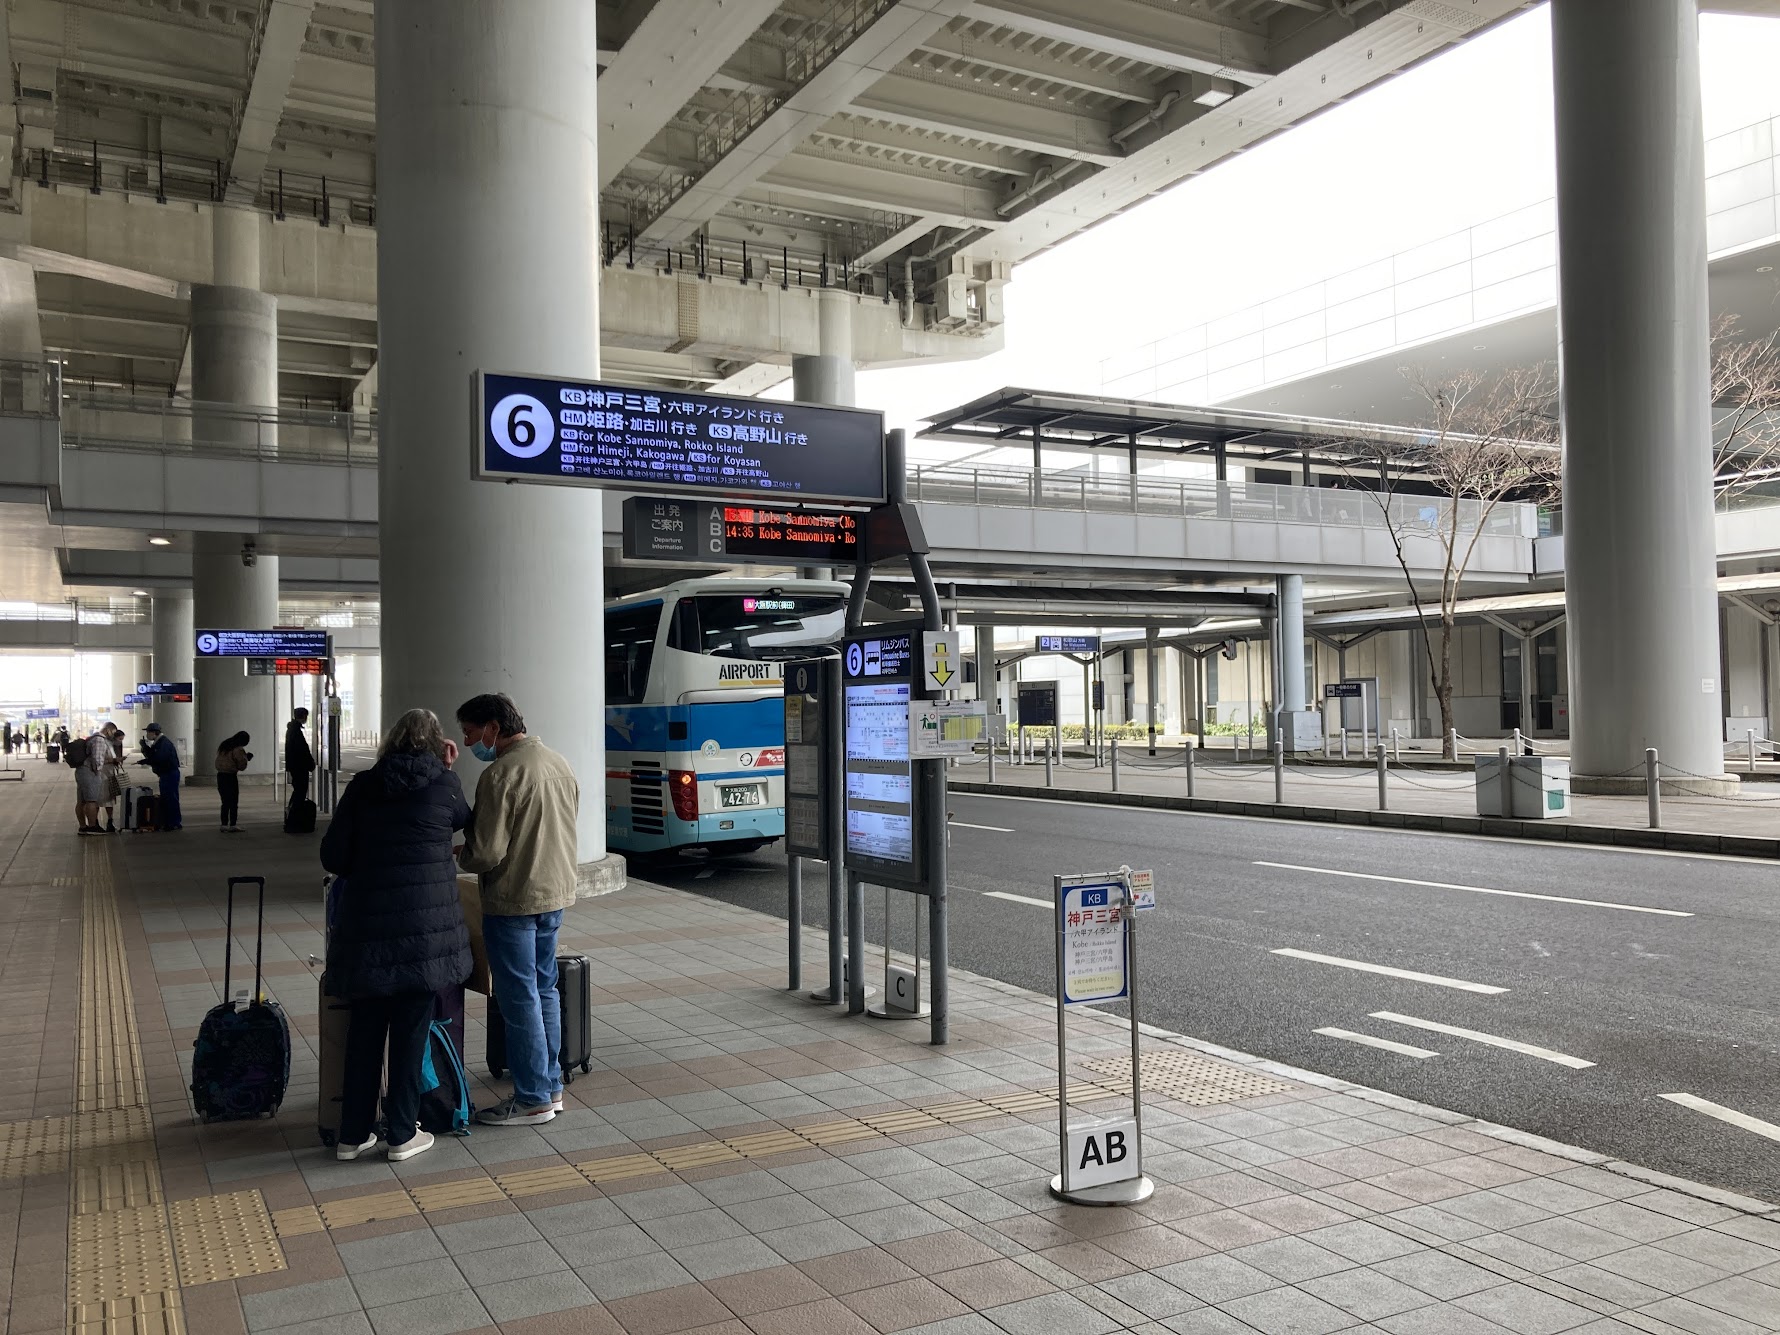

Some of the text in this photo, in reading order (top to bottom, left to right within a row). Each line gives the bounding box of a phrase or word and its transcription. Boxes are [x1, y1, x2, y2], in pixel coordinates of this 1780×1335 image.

[563, 390, 583, 403] KB
[760, 410, 785, 424] 行き
[506, 404, 536, 448] 6
[563, 411, 584, 424] HM
[671, 420, 697, 435] 行き
[711, 425, 731, 437] KS
[733, 424, 782, 444] 高野山
[785, 432, 808, 445] 行き
[579, 430, 594, 441] for
[597, 431, 622, 444] Kobe
[625, 434, 681, 450] Sannomiya,
[684, 439, 713, 452] Rokko
[716, 442, 743, 454] Island
[579, 443, 594, 454] for
[597, 444, 633, 459] Himeji,
[636, 447, 685, 463] Kakogawa
[707, 454, 721, 464] for
[724, 455, 761, 468] Koyasan
[709, 506, 722, 520] A
[759, 510, 781, 524] Kobe
[786, 512, 836, 527] Sannomiya
[651, 519, 684, 531] ご案内
[710, 522, 722, 536] B
[654, 536, 682, 544] Departure
[726, 525, 754, 539] 14:35
[759, 527, 781, 540] Kobe
[786, 529, 836, 543] Sannomiya
[710, 538, 722, 552] C
[203, 637, 213, 650] 5
[881, 638, 910, 650] リムジンバス
[1043, 638, 1049, 646] 2
[850, 647, 858, 671] 6
[719, 663, 771, 680] AIRPORT
[728, 791, 759, 805] 42-76
[1088, 893, 1102, 904] KB
[1067, 907, 1120, 927] 神戸三宮
[1072, 940, 1089, 949] Kobe
[896, 976, 906, 998] C
[1079, 1130, 1127, 1170] AB
